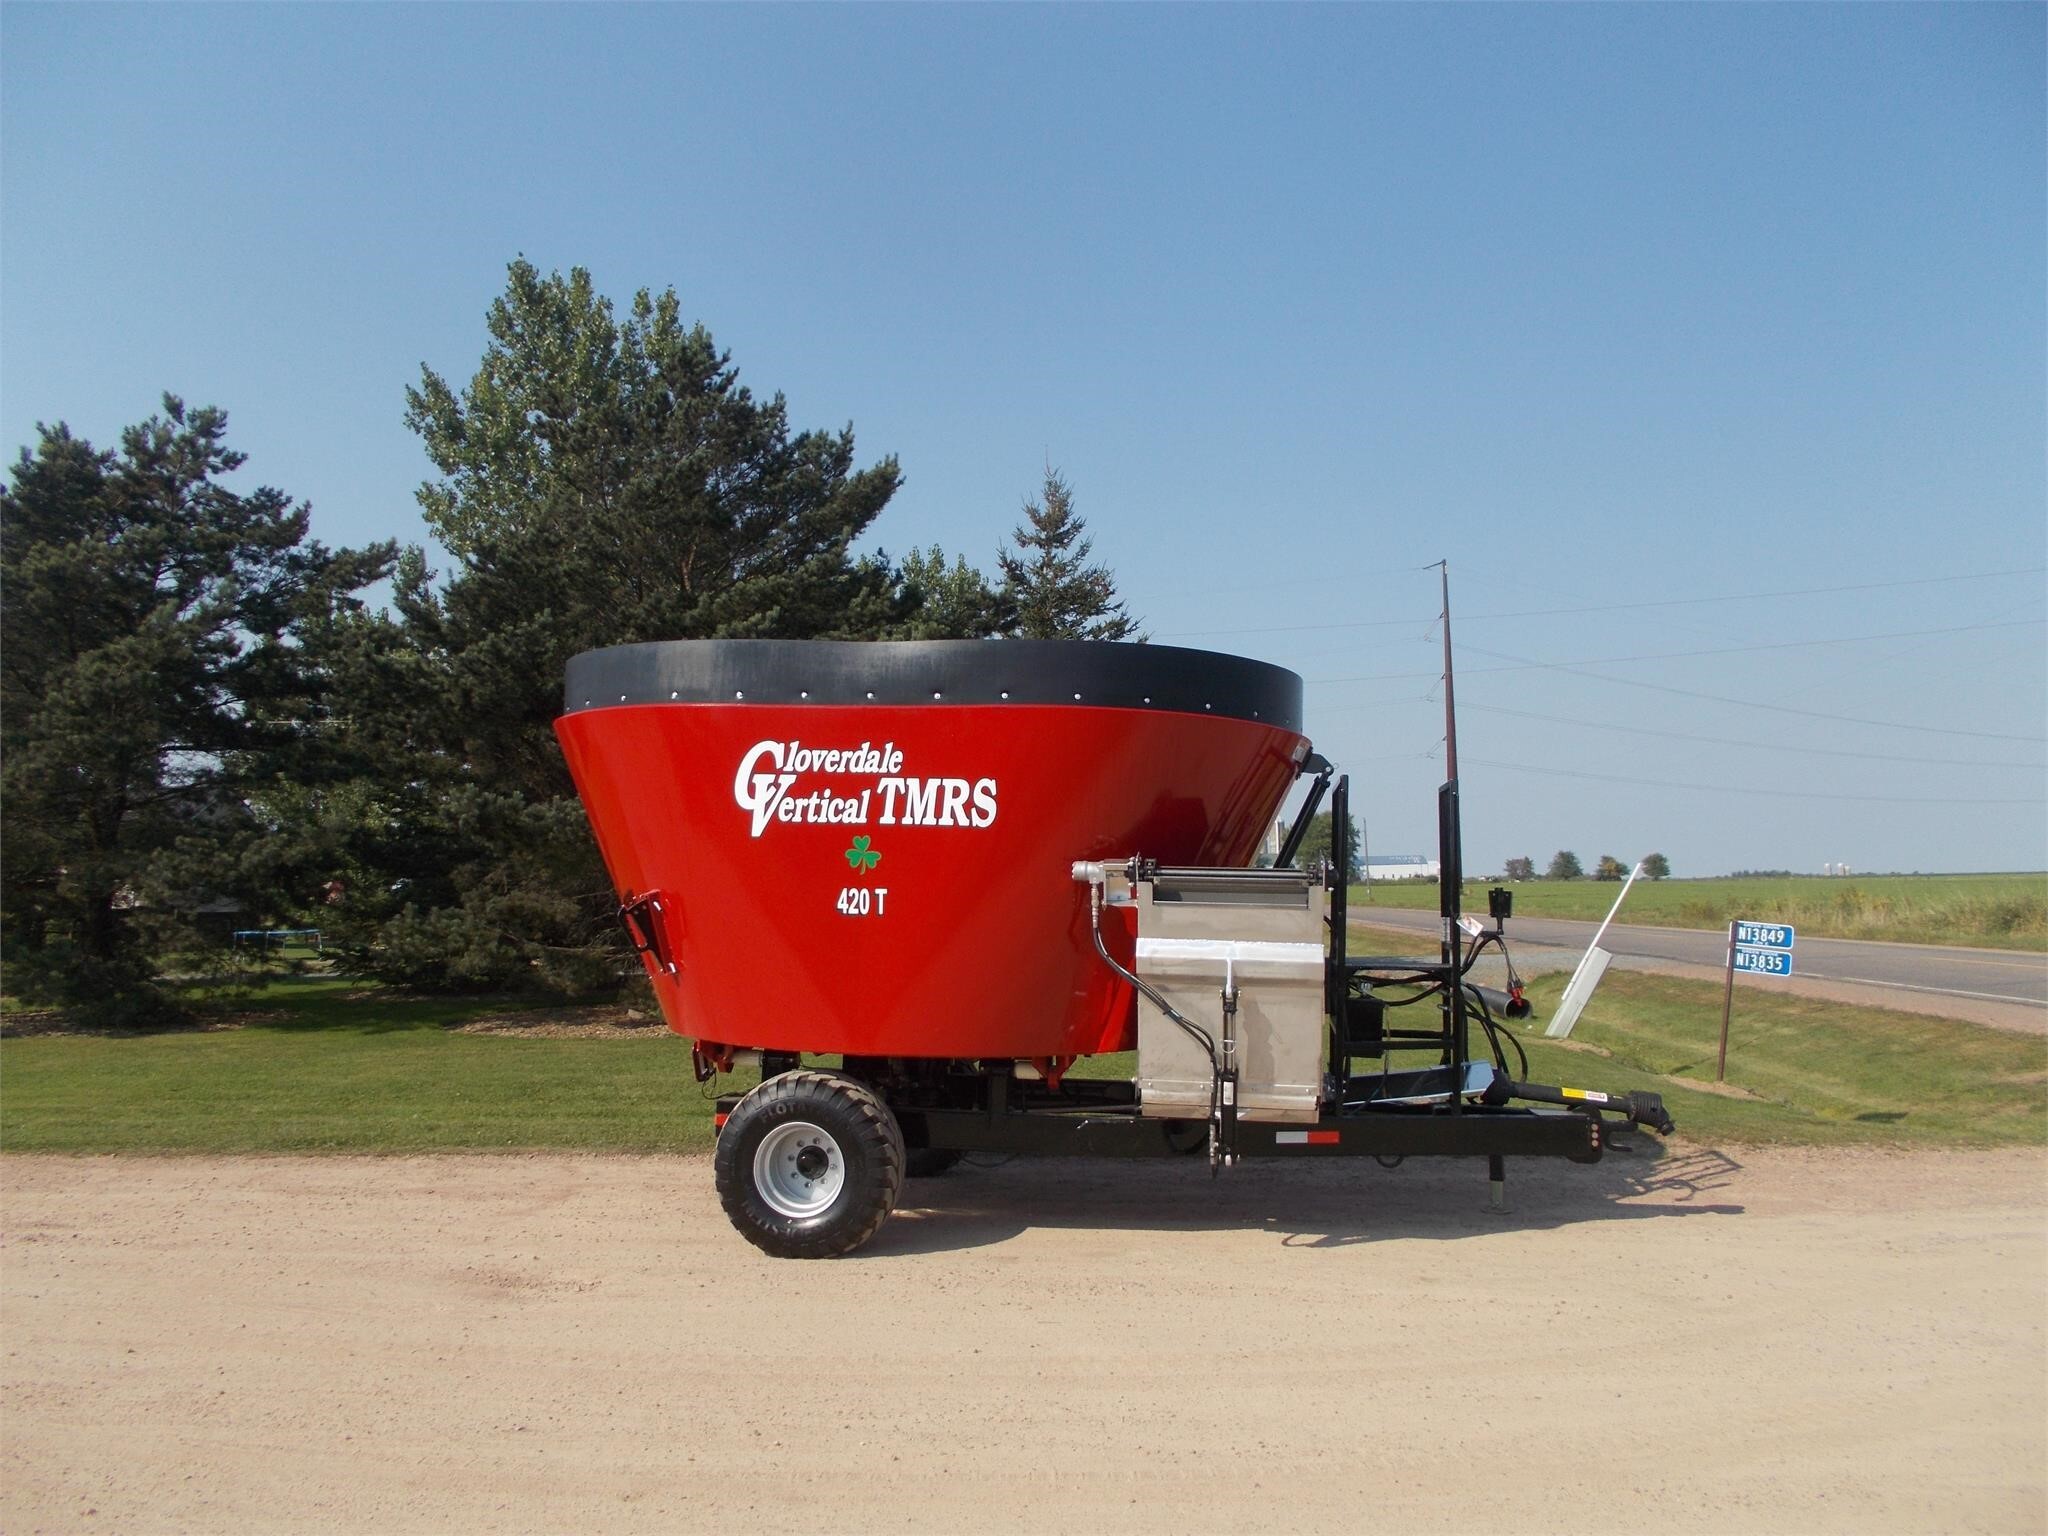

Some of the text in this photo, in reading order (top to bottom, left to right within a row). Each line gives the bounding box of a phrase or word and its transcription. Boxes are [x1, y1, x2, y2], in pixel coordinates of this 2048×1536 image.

[734, 740, 904, 810] Cloverdale
[751, 774, 997, 837] Vertical TMRS
[837, 888, 888, 915] 420 T
[1738, 927, 1785, 943] N13849
[1736, 953, 1783, 970] N13835
